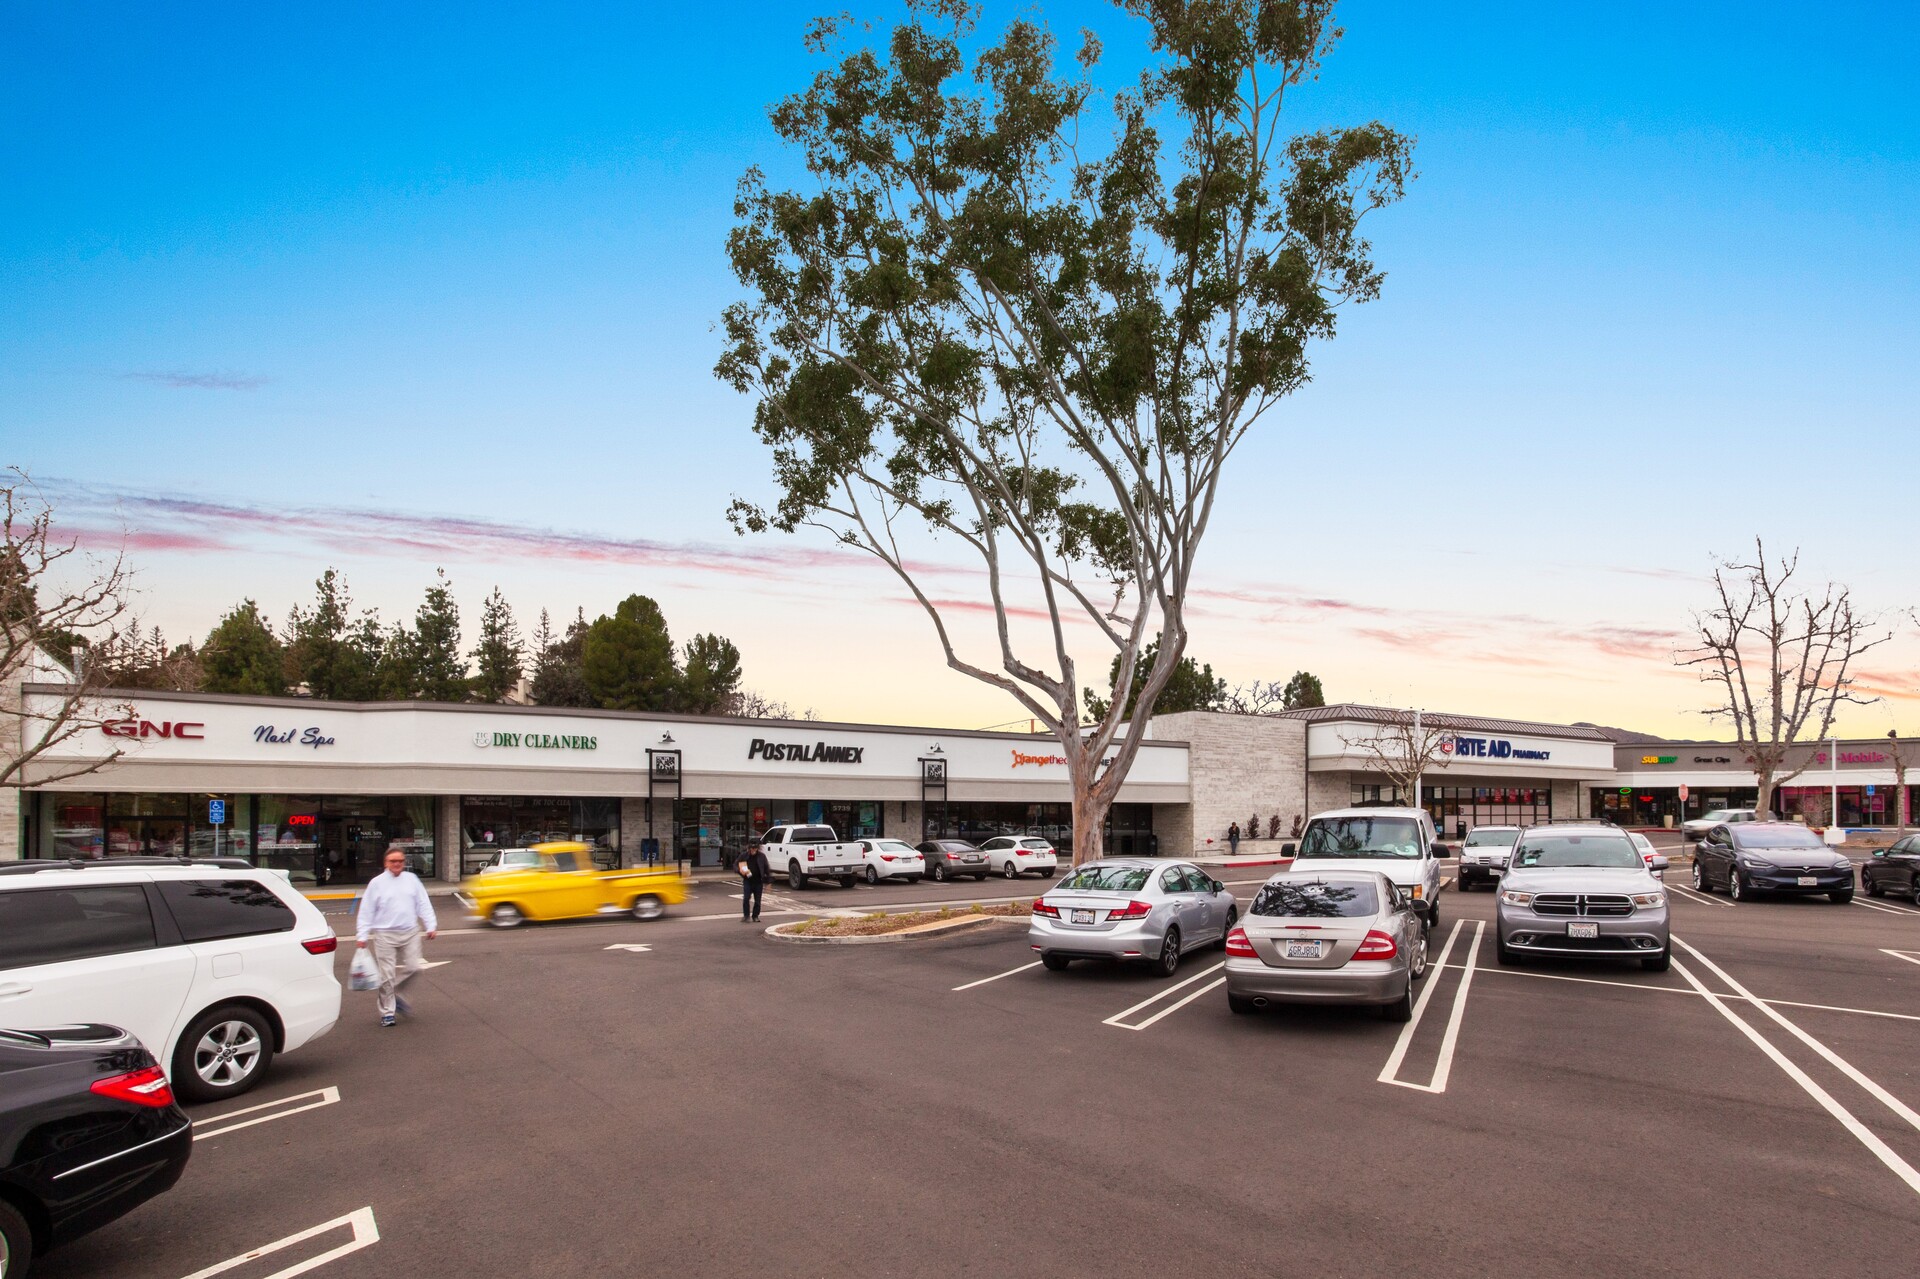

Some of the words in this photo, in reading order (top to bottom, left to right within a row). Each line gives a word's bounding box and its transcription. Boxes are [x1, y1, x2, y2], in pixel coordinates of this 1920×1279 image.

[102, 719, 204, 739] GNC
[254, 725, 296, 743] Nail
[300, 727, 335, 749] Spa
[493, 732, 521, 747] DRY
[525, 733, 597, 750] CLEANERS
[1455, 737, 1487, 757] RITE
[1488, 740, 1511, 758] AID
[1513, 749, 1550, 760] PHARMACY
[1641, 756, 1678, 764] SUBWAY
[289, 815, 315, 825] OPEN
[1288, 945, 1319, 956] 6GRJ800
